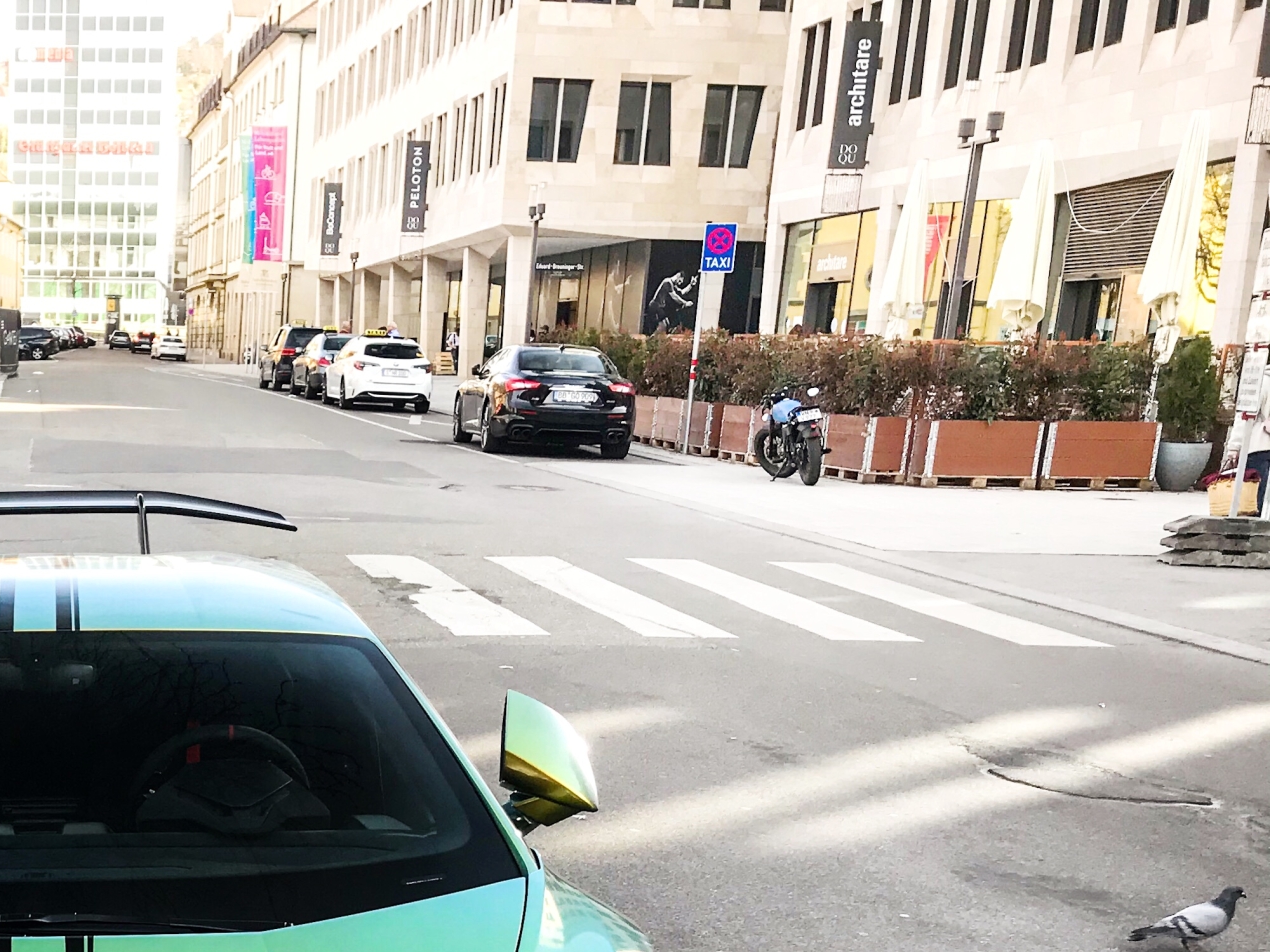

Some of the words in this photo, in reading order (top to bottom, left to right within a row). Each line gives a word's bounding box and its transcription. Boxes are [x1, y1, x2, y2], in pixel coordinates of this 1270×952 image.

[847, 38, 872, 127] architare
[840, 144, 858, 154] DO
[838, 154, 857, 165] QU
[410, 147, 423, 209] PELOTON
[325, 192, 338, 236] BoConcept
[704, 257, 731, 269] TAXI
[816, 253, 848, 272] architare
